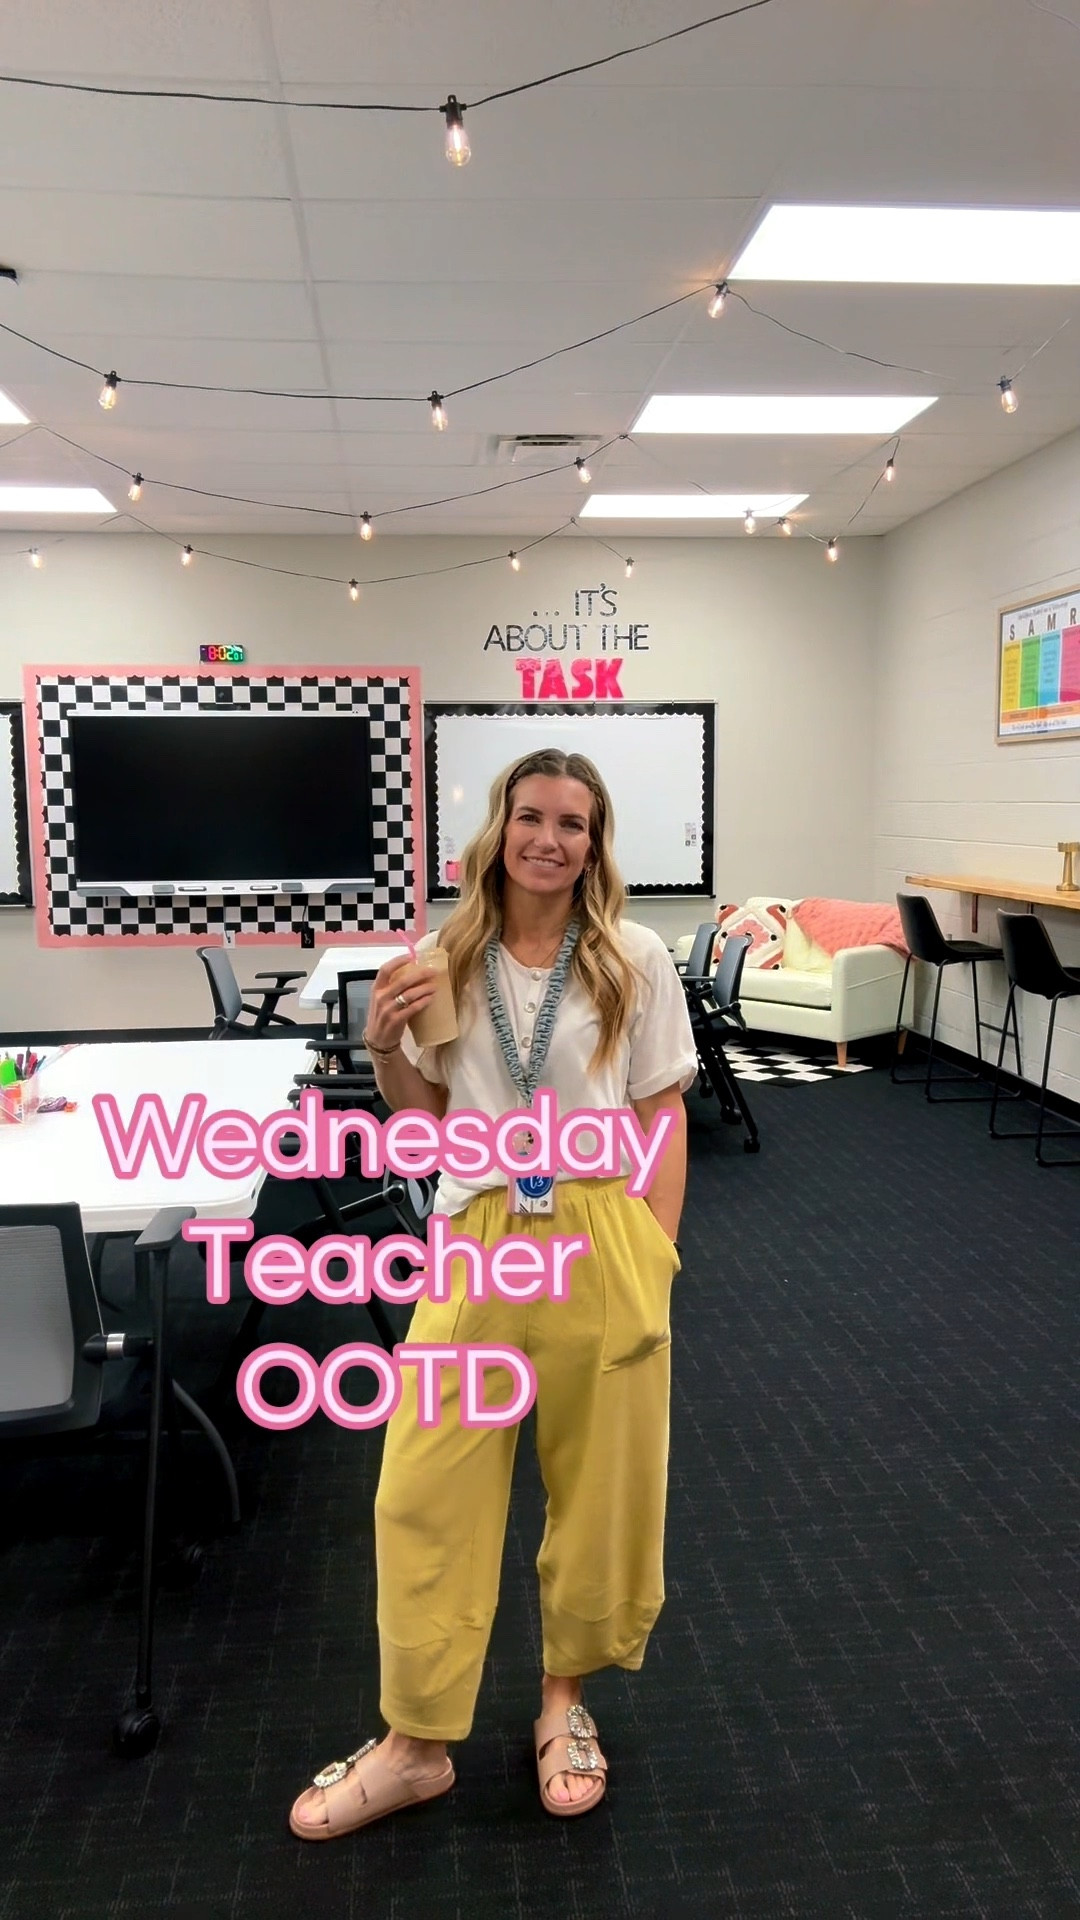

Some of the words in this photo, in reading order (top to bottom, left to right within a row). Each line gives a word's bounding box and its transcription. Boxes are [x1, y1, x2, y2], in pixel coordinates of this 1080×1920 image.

[574, 583, 618, 617] IT'S
[483, 624, 587, 651] ABOUT
[596, 624, 649, 651] THE
[515, 658, 624, 699] TASK
